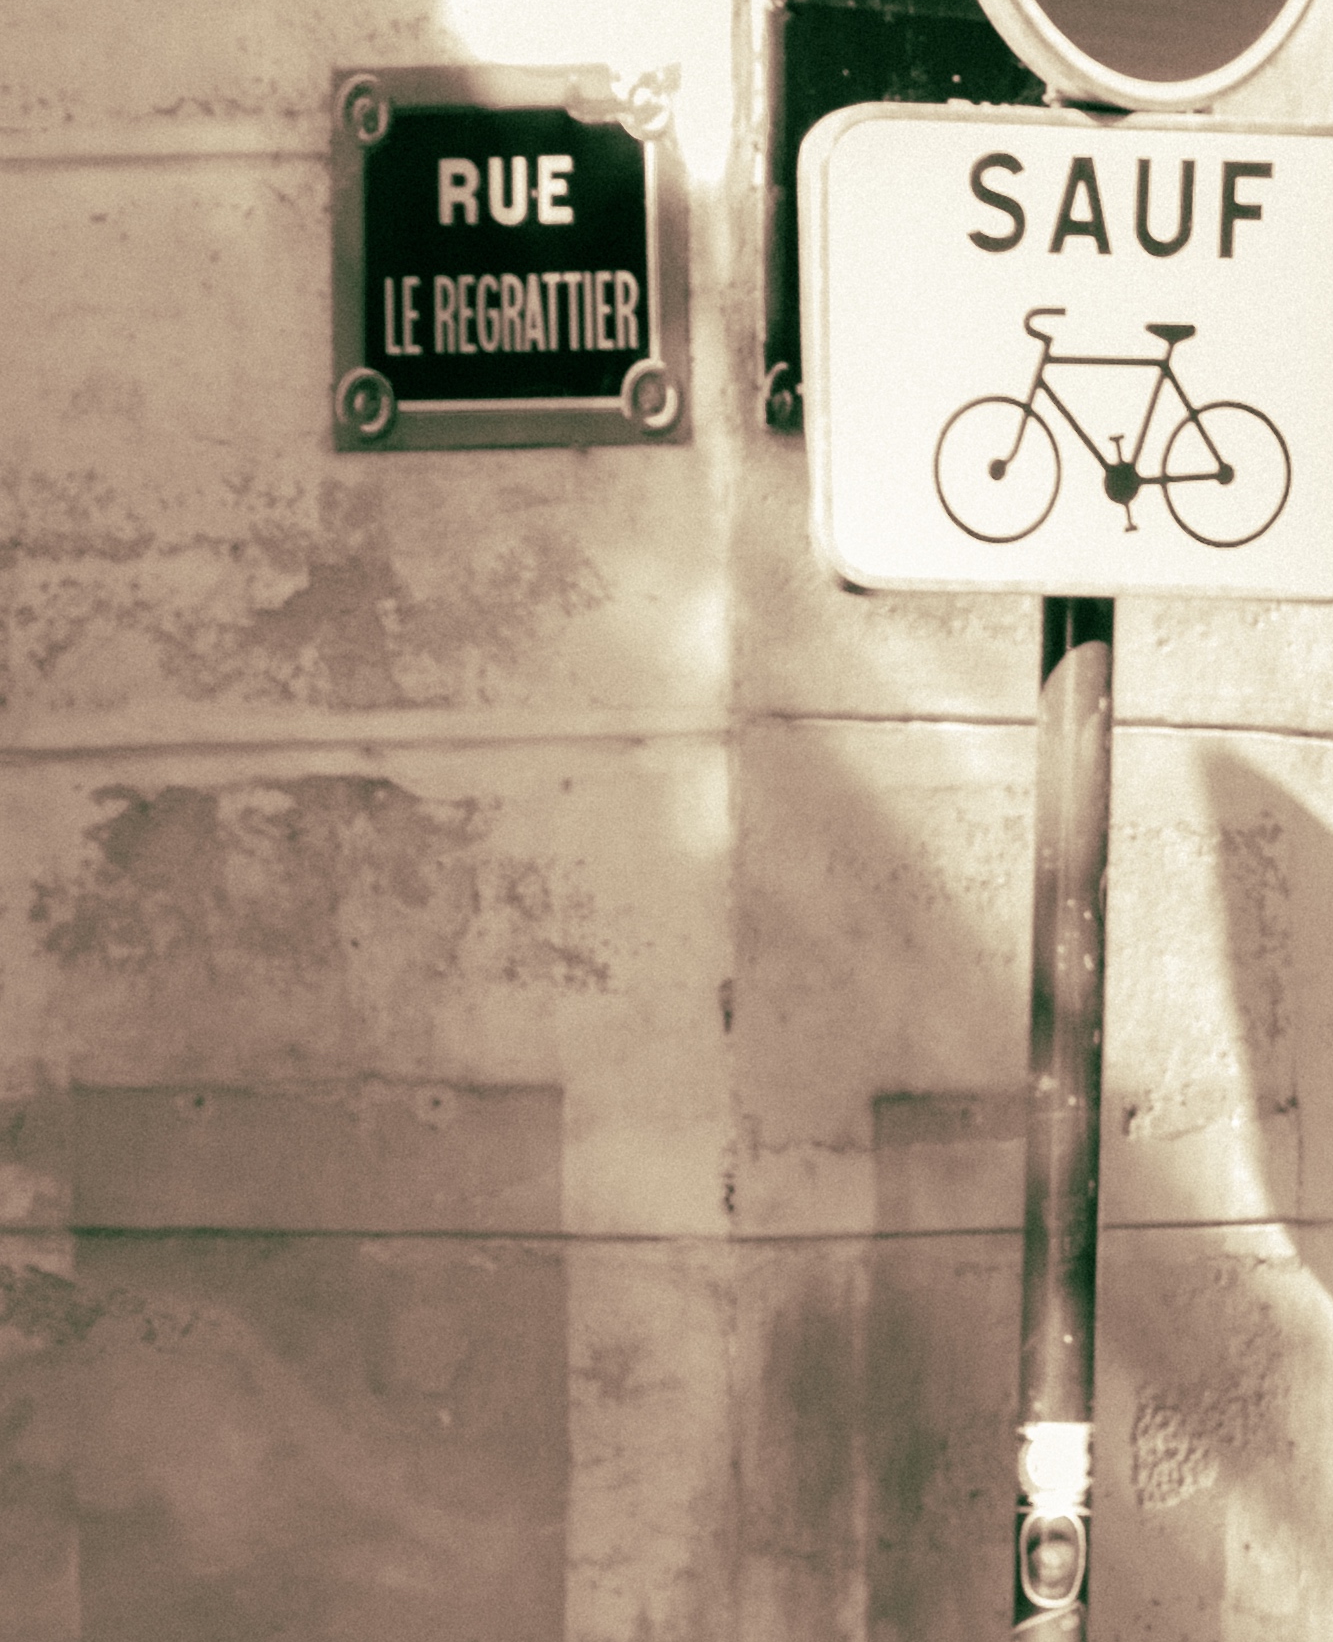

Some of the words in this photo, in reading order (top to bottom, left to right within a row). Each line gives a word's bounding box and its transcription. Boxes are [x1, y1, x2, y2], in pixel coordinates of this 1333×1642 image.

[437, 154, 575, 226] RUE
[967, 152, 1274, 259] SAUF
[383, 275, 423, 355] LE
[433, 269, 640, 354] REGRATTIER
